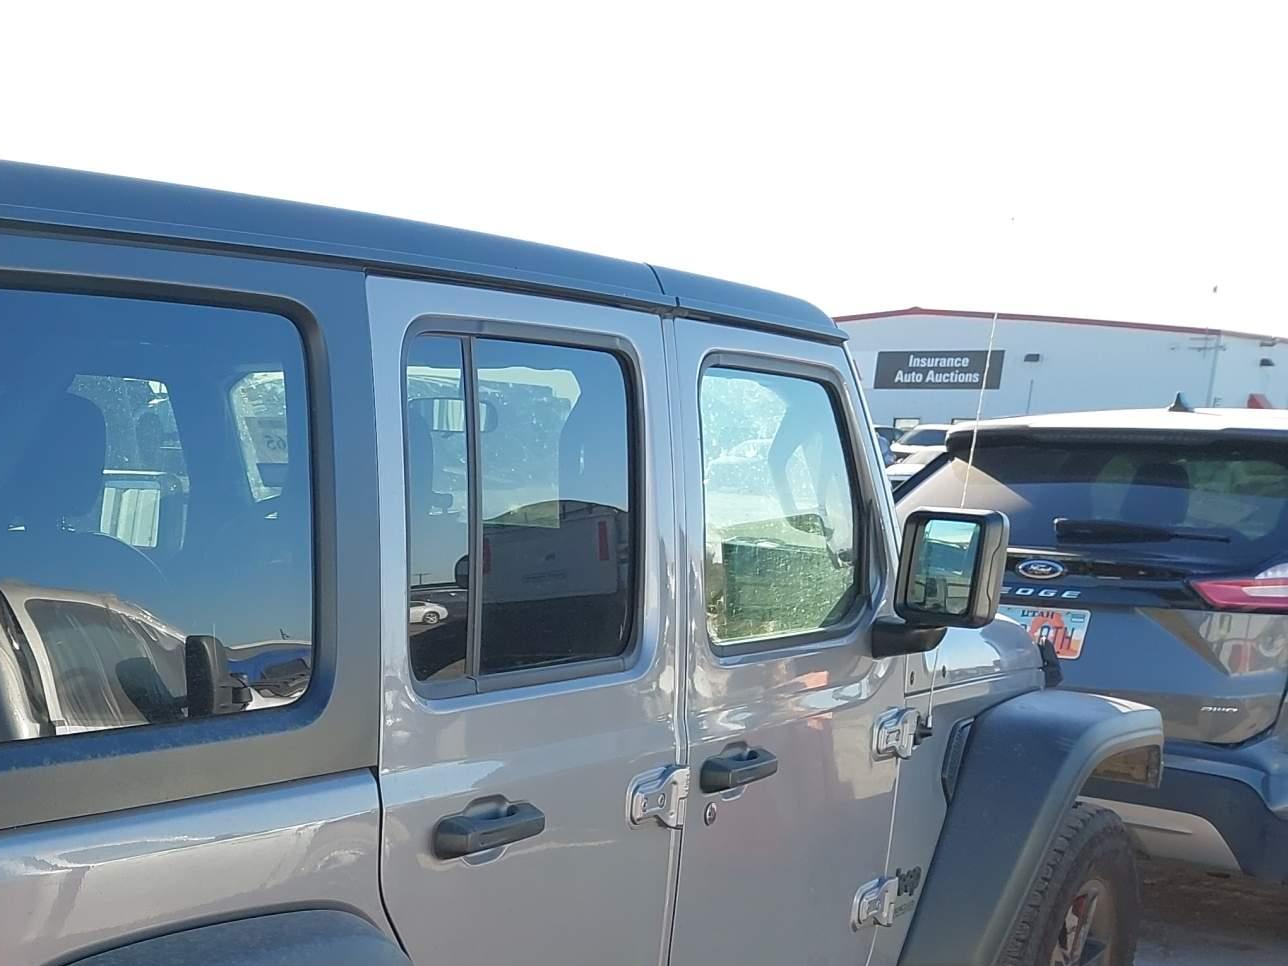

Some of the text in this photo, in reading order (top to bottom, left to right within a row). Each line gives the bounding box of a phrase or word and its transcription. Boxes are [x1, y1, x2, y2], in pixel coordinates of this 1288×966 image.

[908, 355, 970, 368] Insurance
[894, 370, 980, 384] Auto Auctions
[1020, 609, 1054, 619] UTAH
